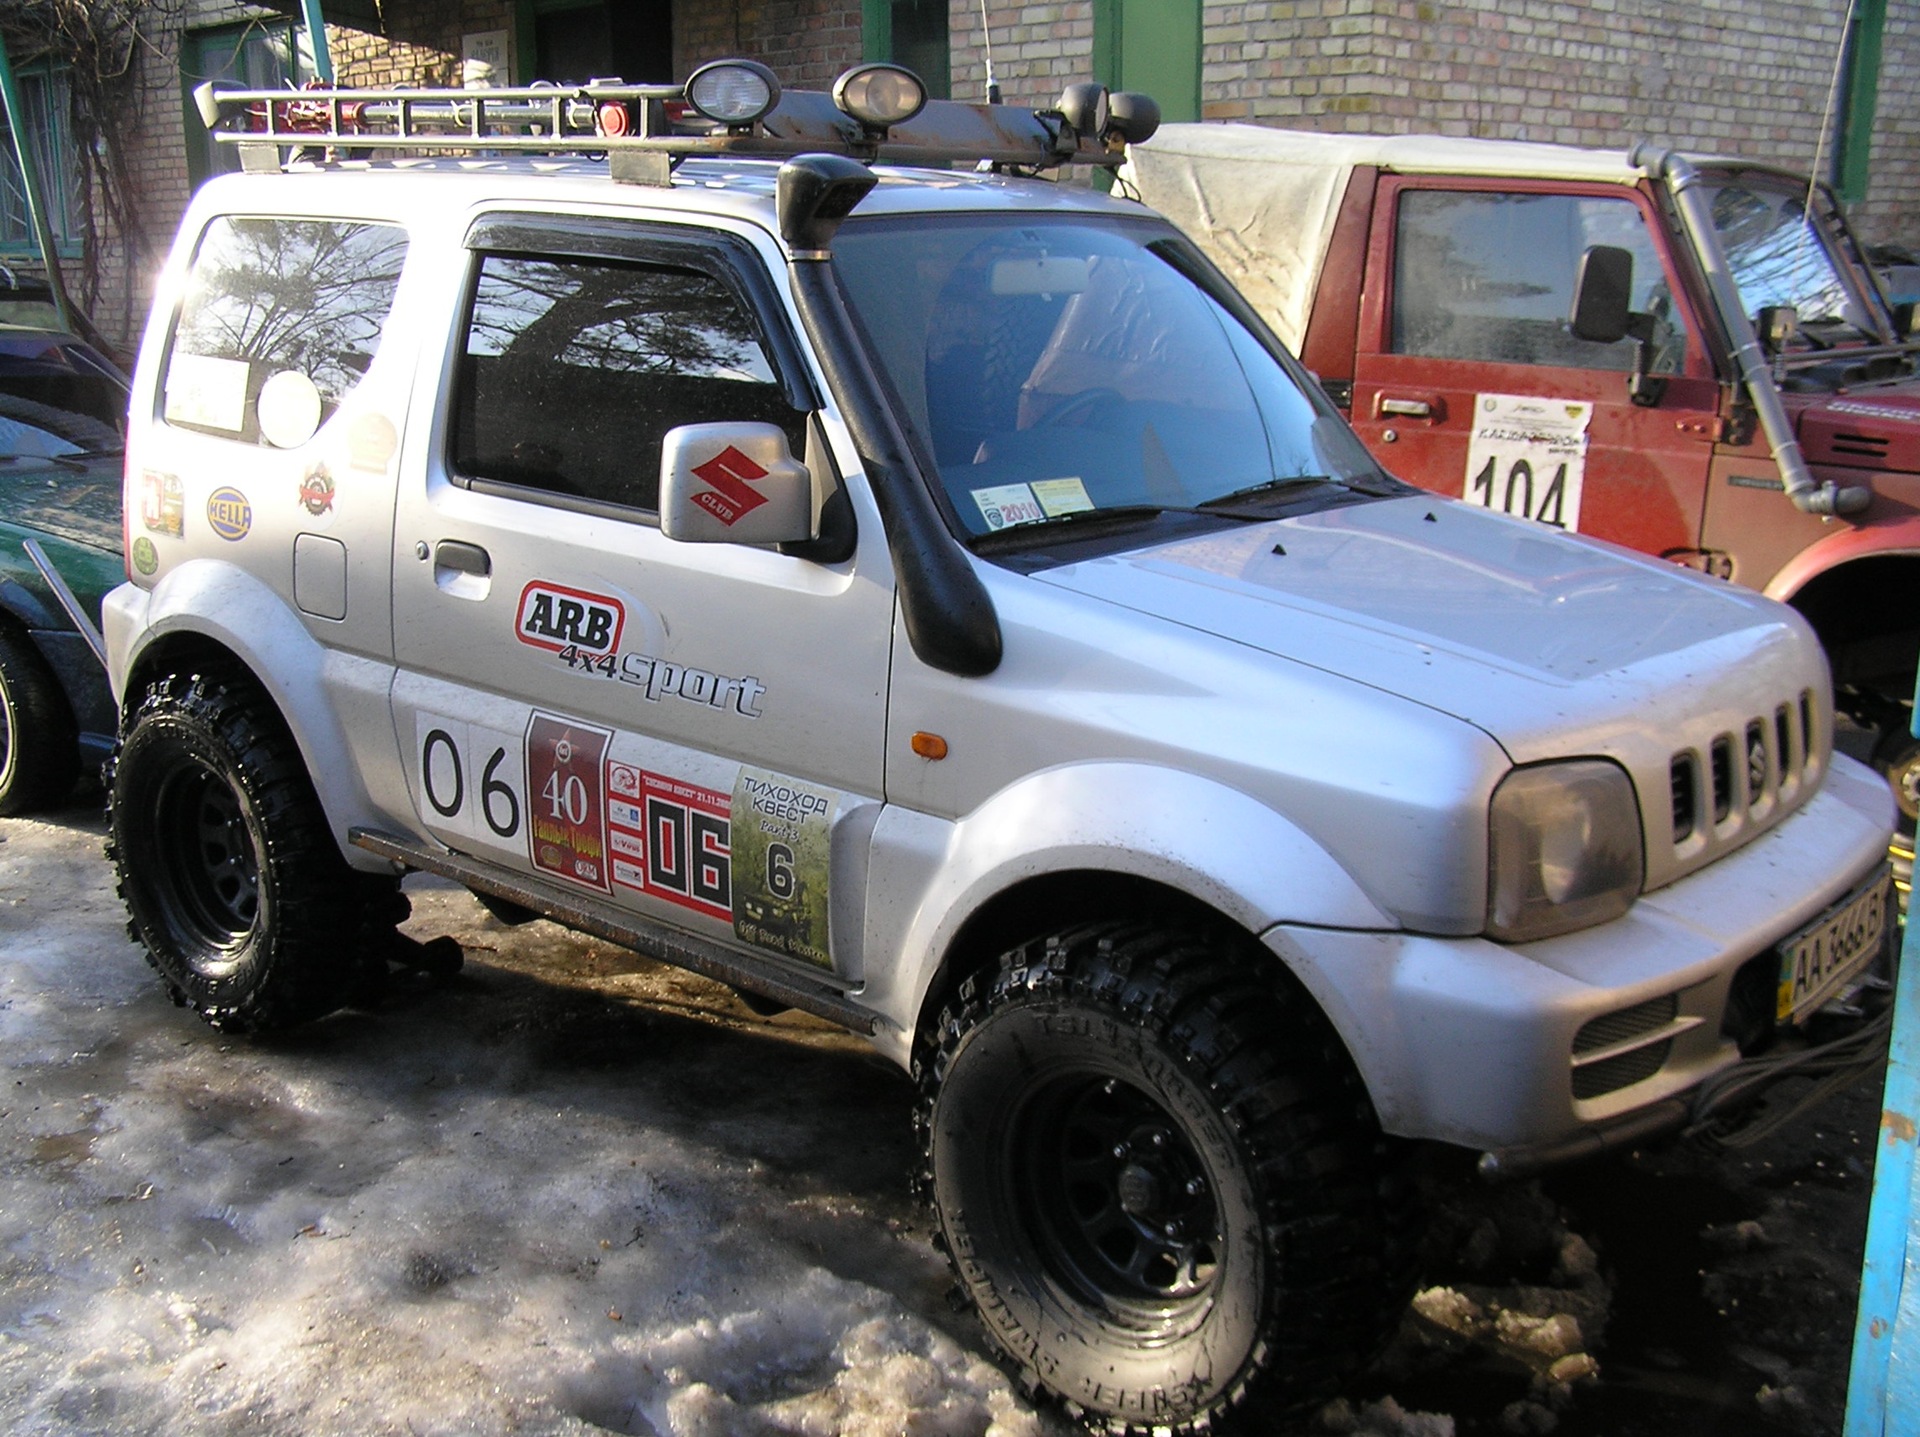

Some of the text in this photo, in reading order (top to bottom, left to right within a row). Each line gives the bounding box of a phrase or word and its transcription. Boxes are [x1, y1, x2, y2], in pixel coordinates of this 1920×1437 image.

[209, 501, 252, 530] HELLA
[701, 493, 735, 520] CLUB
[1001, 501, 1041, 523] 2010
[1473, 454, 1568, 529] 104
[525, 592, 613, 650] ARB
[558, 644, 617, 679] 4x4
[619, 651, 767, 718] sport
[422, 728, 520, 838] 06
[542, 770, 588, 826] 40
[744, 776, 829, 816] ТИХОХОД
[752, 799, 810, 825] КВЕСТ
[760, 820, 788, 838] Part
[648, 797, 732, 909] 06
[767, 841, 796, 900] 6
